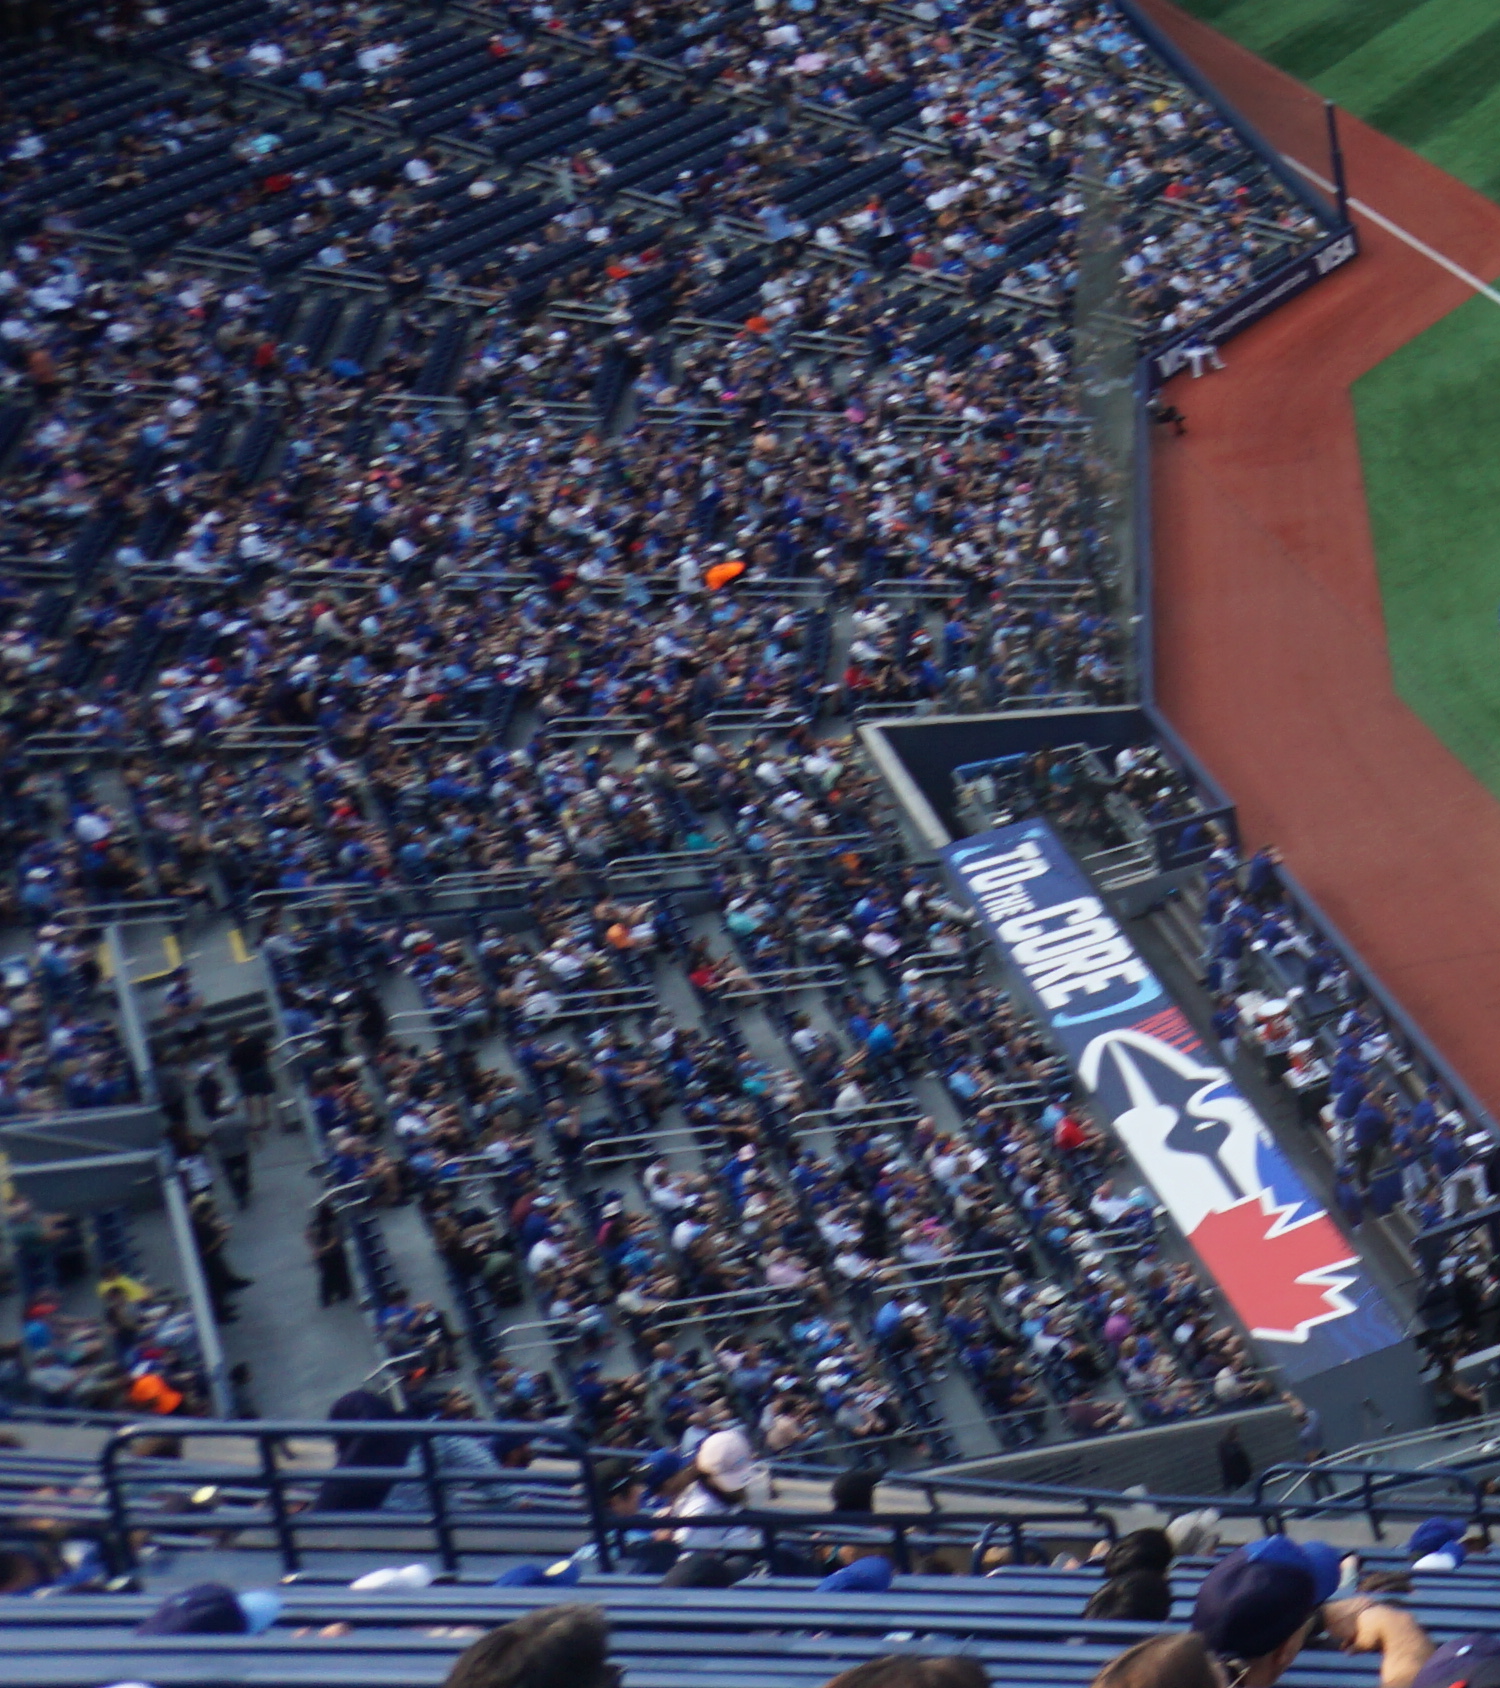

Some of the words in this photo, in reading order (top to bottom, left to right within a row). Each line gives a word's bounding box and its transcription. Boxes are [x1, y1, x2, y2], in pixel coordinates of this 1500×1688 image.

[960, 841, 1053, 894] TO
[978, 884, 1037, 921] THE
[998, 896, 1150, 1009] CORE
